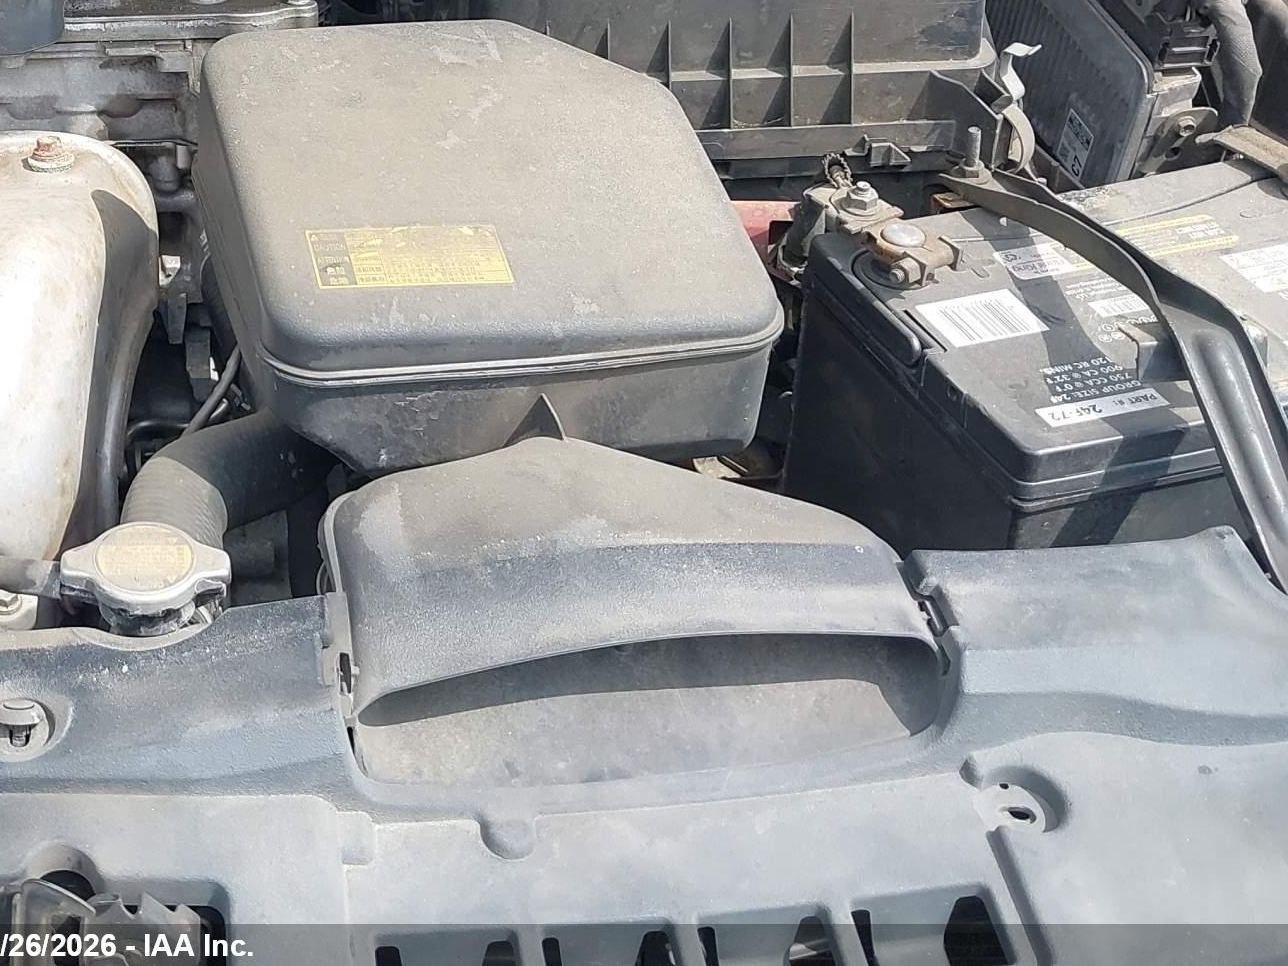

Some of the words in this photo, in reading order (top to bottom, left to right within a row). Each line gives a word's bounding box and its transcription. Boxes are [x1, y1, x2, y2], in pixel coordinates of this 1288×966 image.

[1073, 360, 1091, 370] RC
[1081, 368, 1099, 377] CA
[1110, 372, 1133, 382] 750
[1083, 375, 1108, 386] CCA
[1102, 379, 1142, 393] GROUP
[1128, 393, 1158, 404] PART
[1047, 404, 1103, 421] 24F-72
